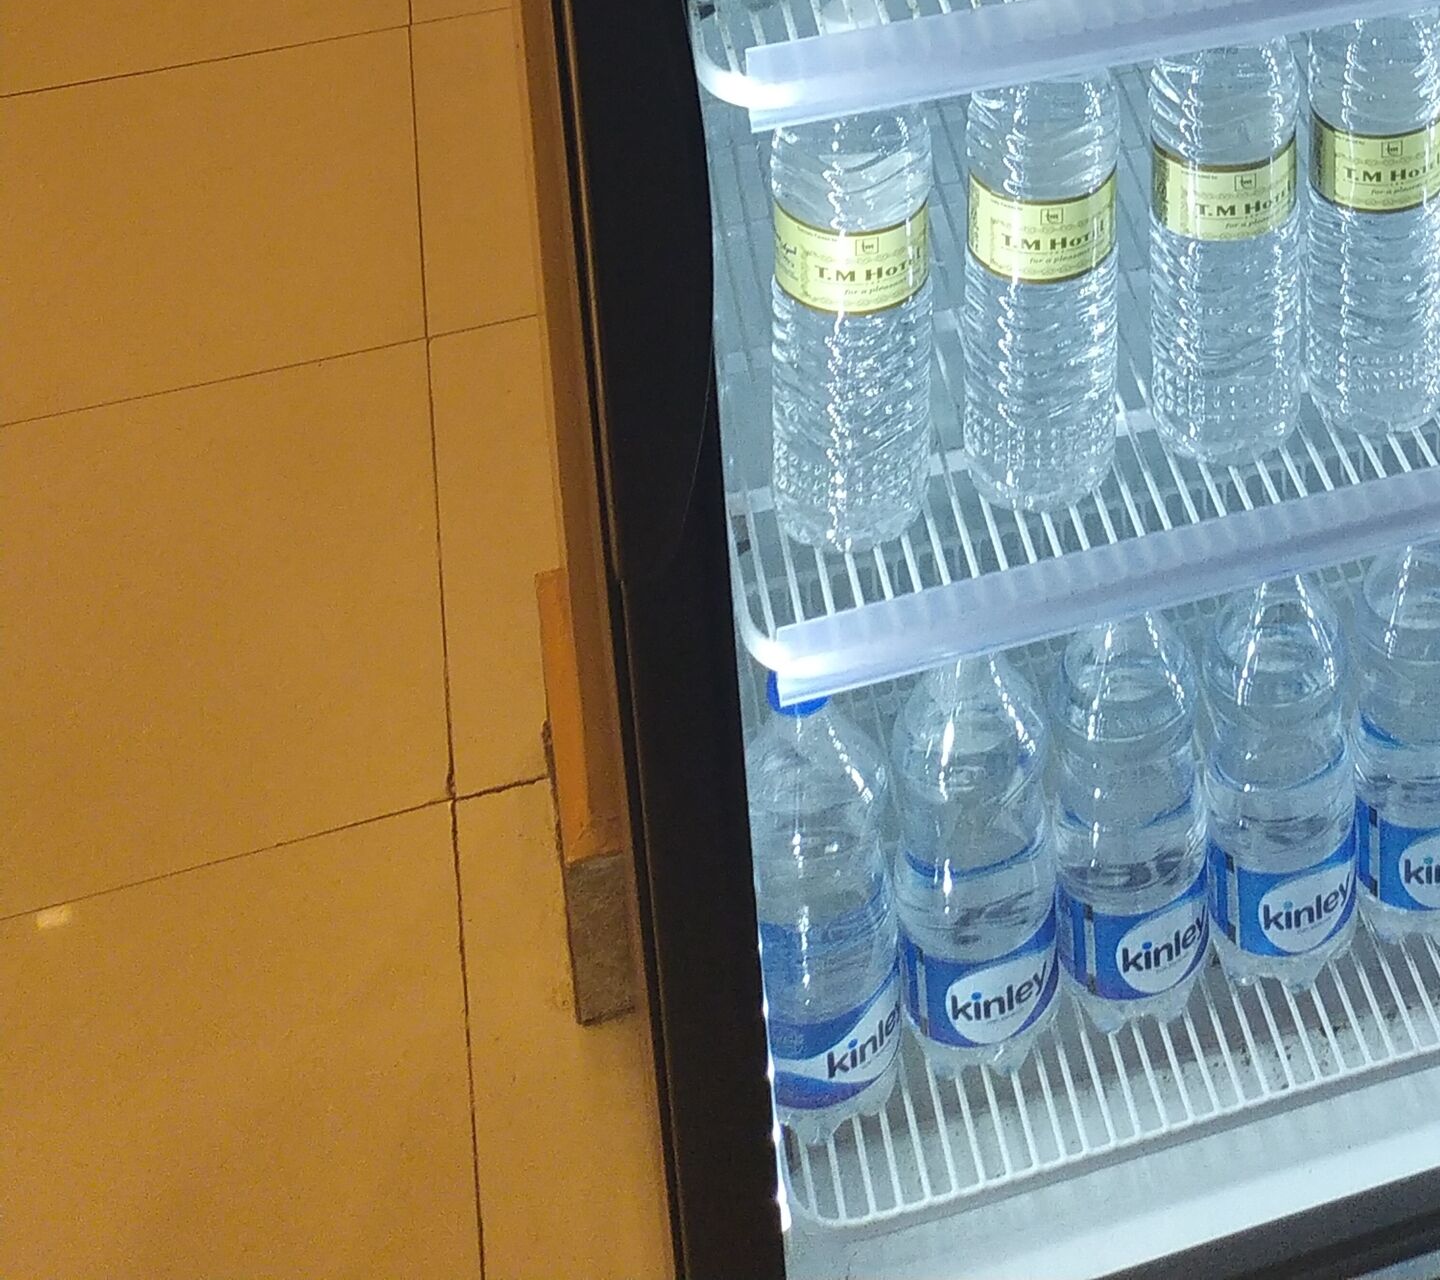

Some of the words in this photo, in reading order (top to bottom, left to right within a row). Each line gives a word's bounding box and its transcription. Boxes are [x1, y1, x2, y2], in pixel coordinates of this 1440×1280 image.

[1263, 871, 1350, 932] kinley
[950, 961, 1046, 1022] kinley
[827, 1002, 899, 1079] kinle
